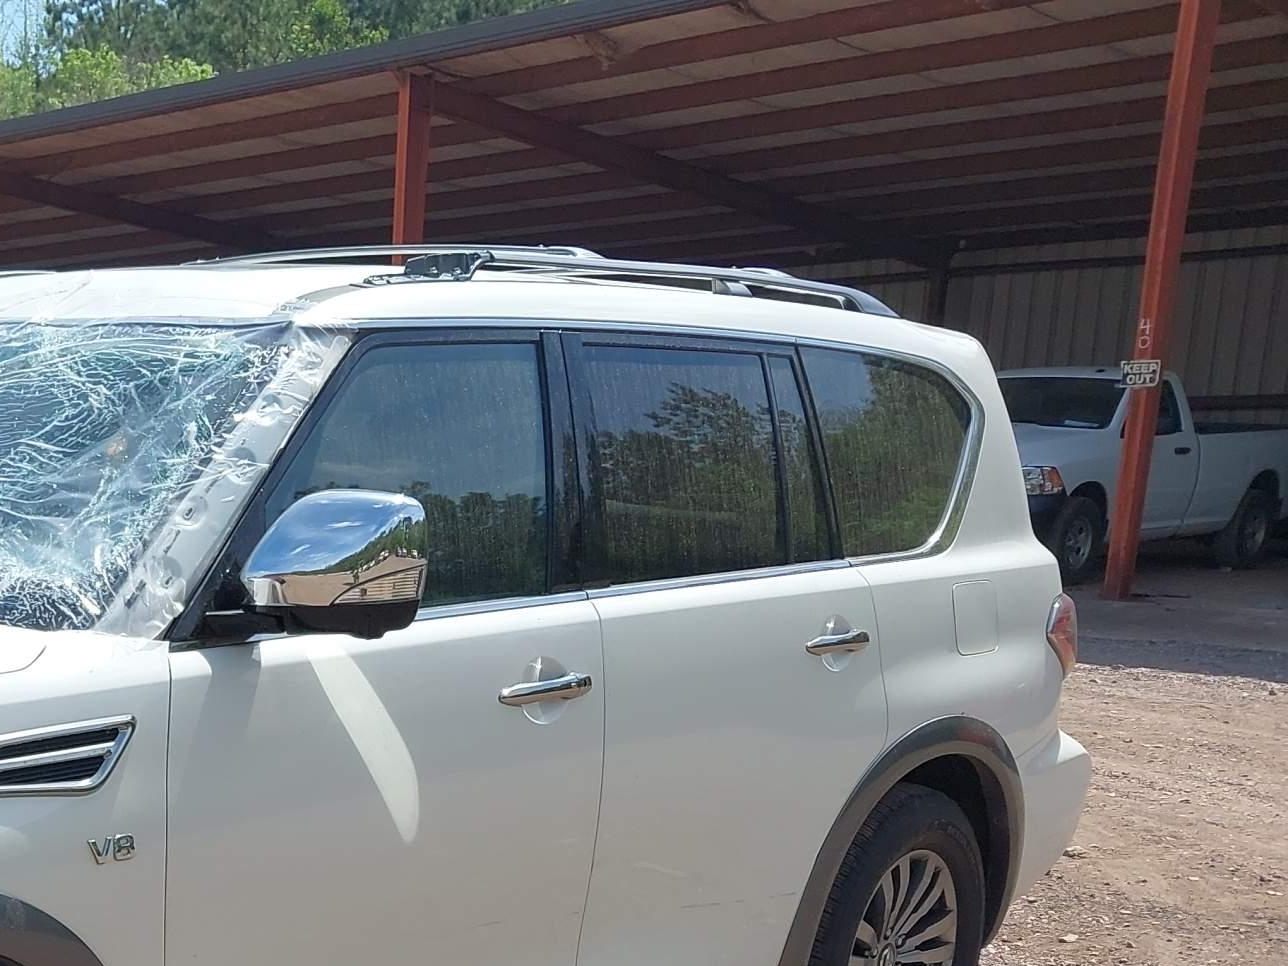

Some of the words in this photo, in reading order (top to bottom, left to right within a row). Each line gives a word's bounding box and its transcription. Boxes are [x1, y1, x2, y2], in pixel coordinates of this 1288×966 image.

[1124, 363, 1157, 374] KEEP
[1126, 374, 1153, 385] OUT
[87, 833, 136, 865] V8
